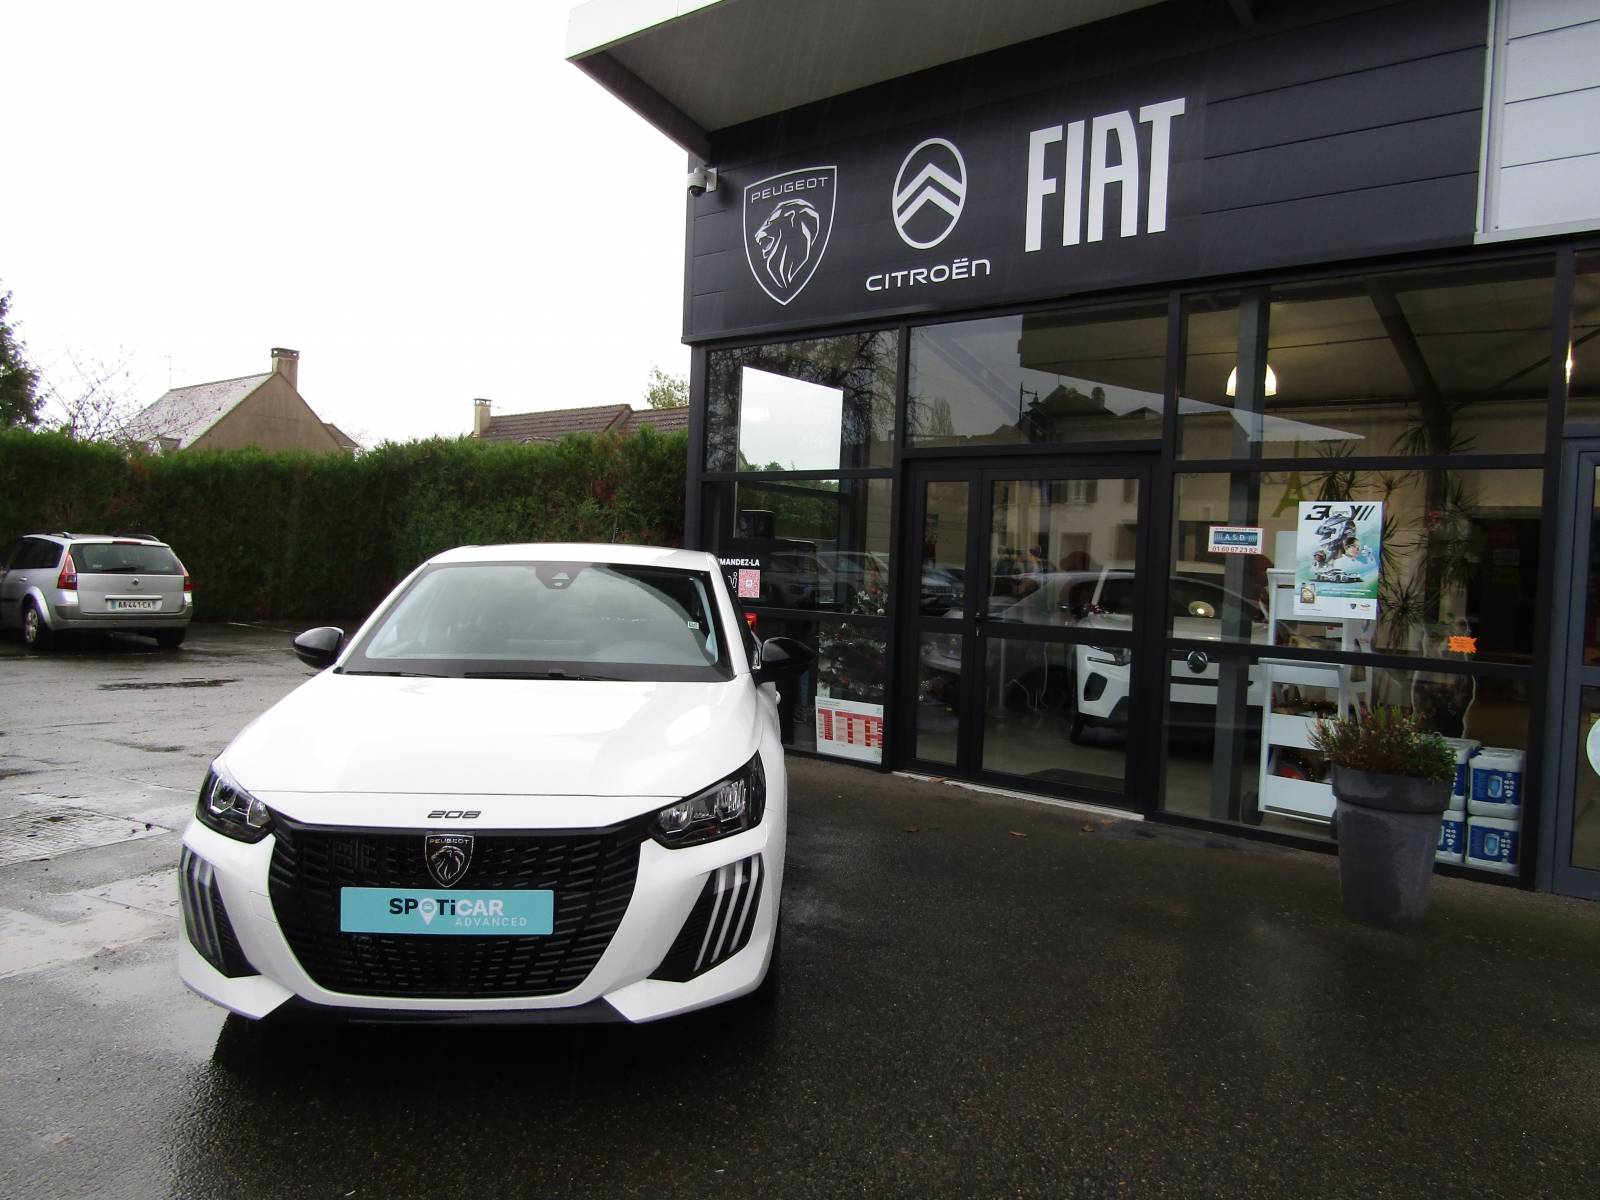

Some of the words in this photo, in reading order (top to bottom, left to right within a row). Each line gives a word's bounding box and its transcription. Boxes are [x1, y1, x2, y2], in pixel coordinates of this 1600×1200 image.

[1025, 97, 1186, 253] FIAT
[750, 175, 829, 203] PEUGEOT
[718, 557, 761, 567] MANDEZ-LA
[427, 810, 482, 819] 208
[429, 837, 470, 845] PEUGEOT
[455, 917, 527, 927] ADVANCED
